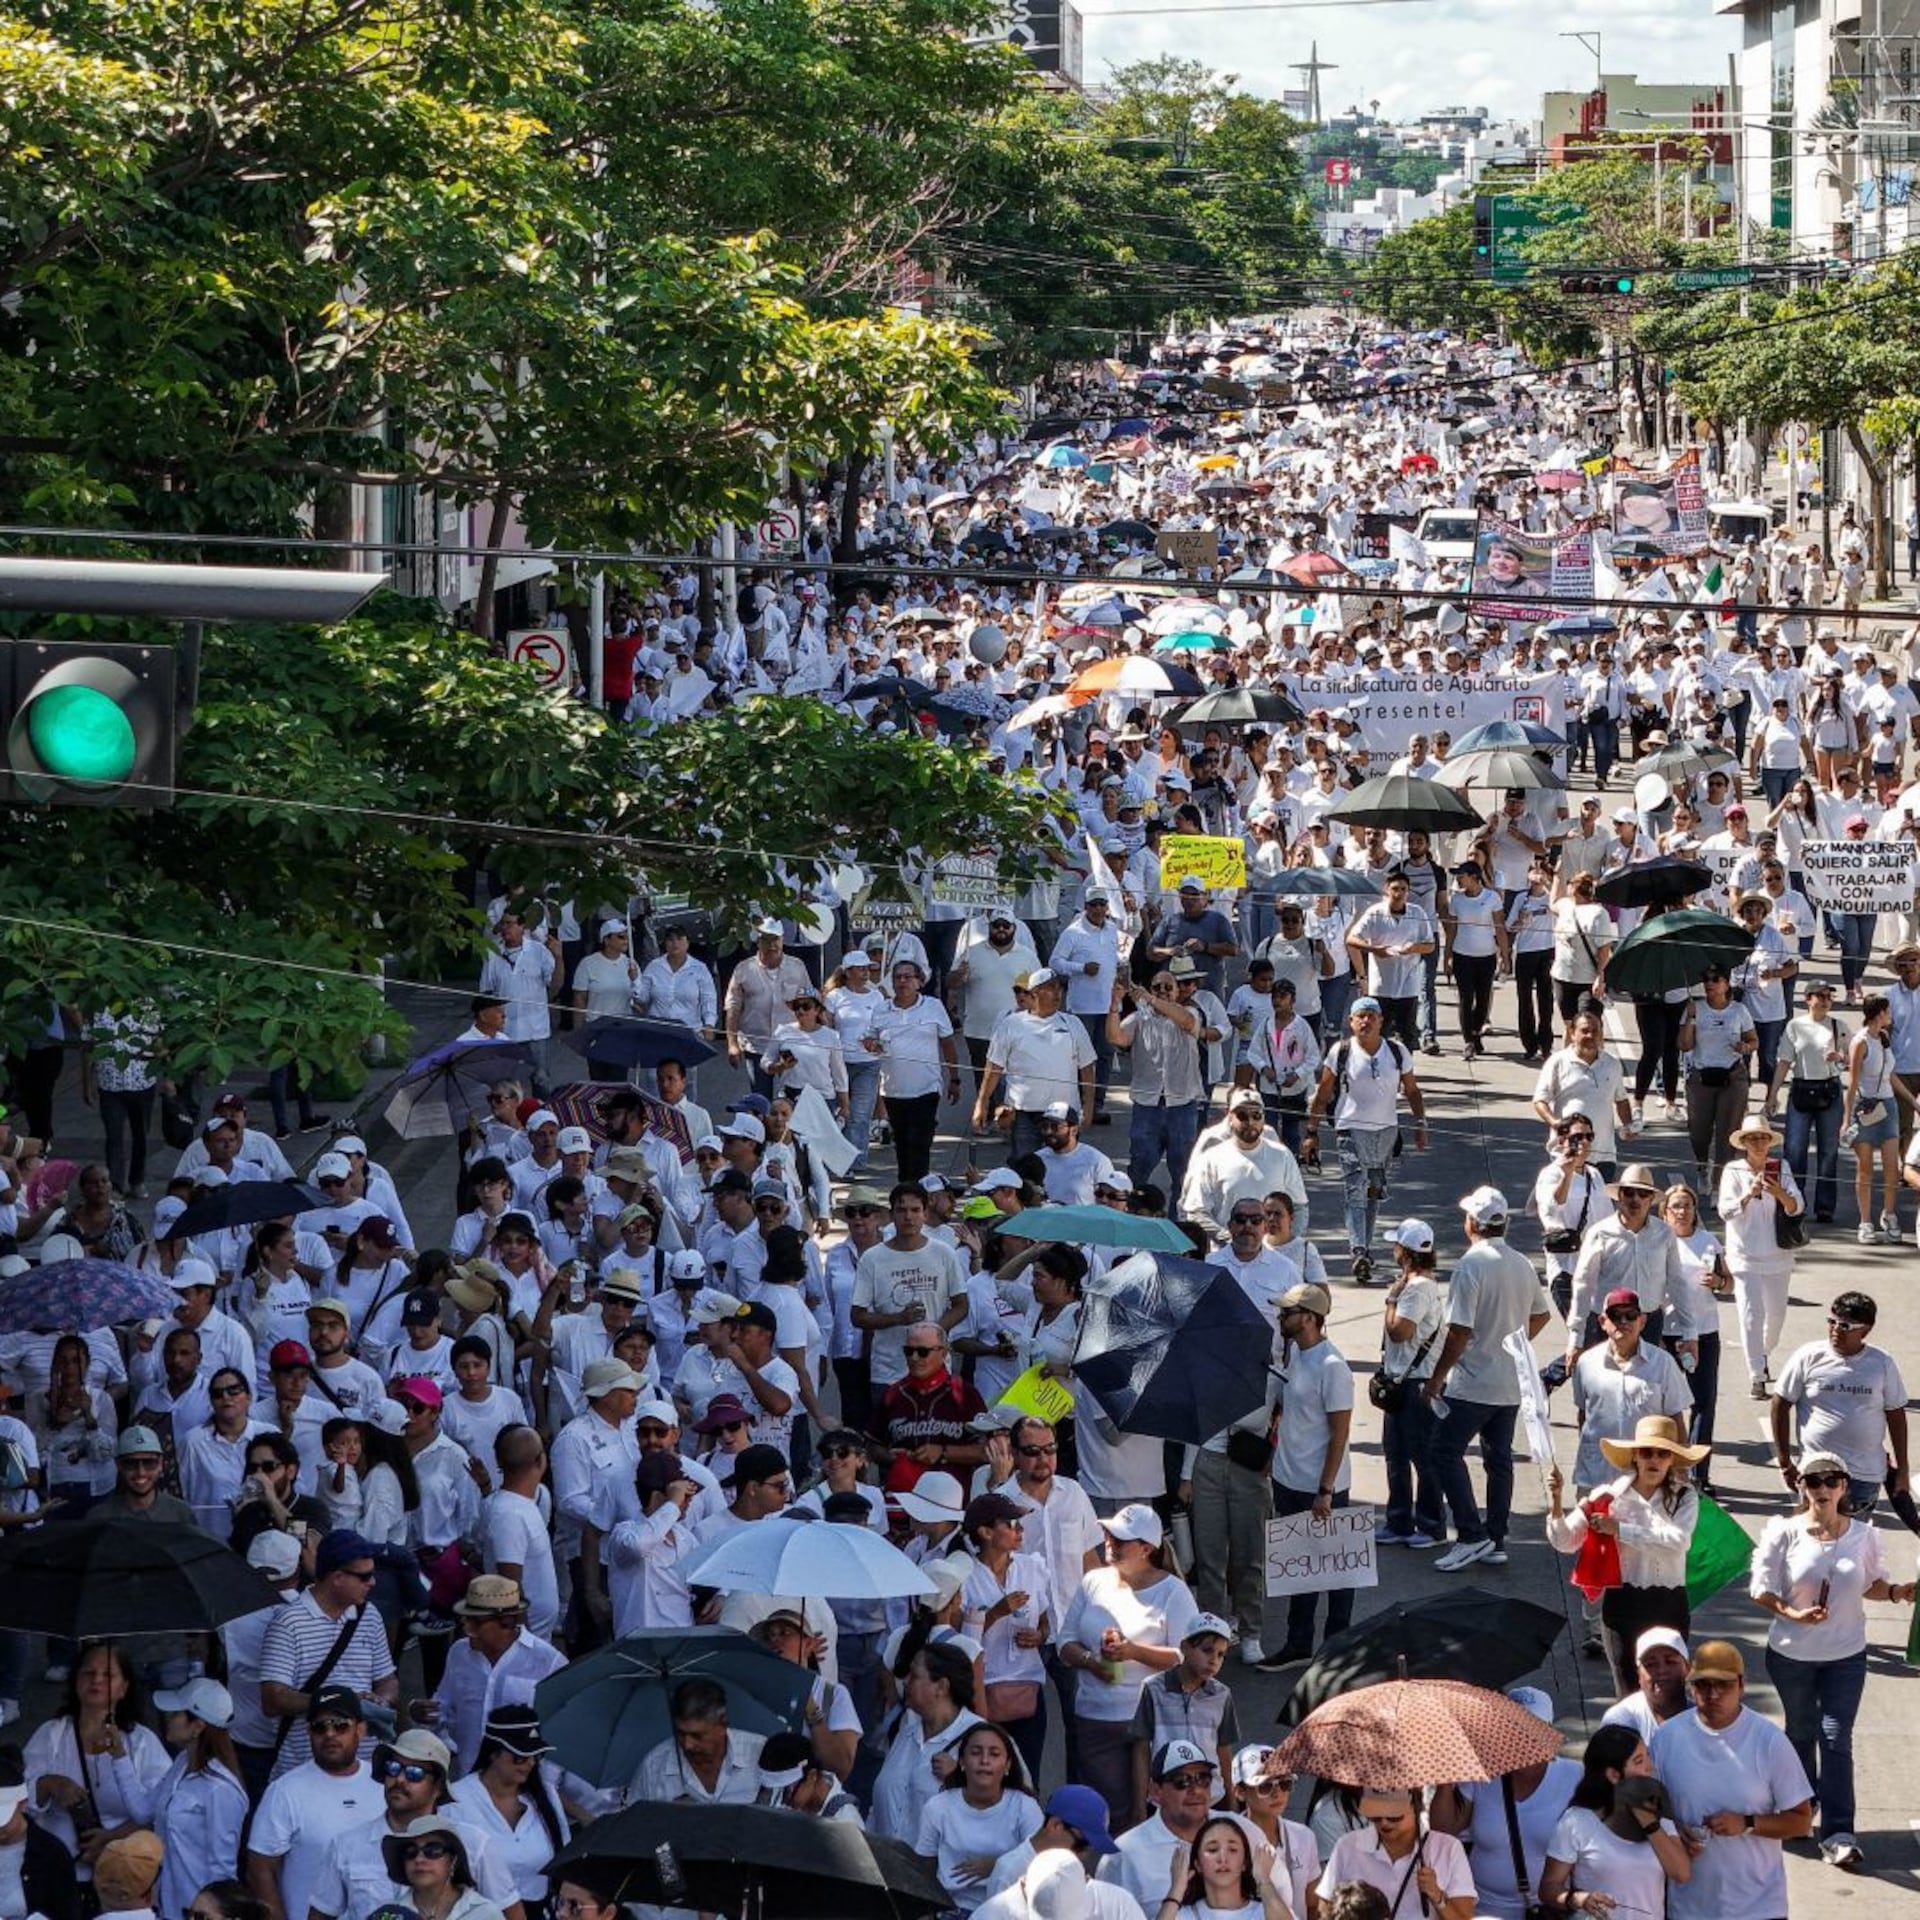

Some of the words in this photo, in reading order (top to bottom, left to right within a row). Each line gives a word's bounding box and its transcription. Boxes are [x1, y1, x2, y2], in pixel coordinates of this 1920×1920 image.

[1176, 535, 1204, 549] PAZ
[1300, 677, 1321, 692] La
[1326, 675, 1418, 694] sindicatura
[1423, 675, 1443, 692] de
[1801, 842, 1829, 854] SOY
[1831, 842, 1916, 855] MANICURISTA
[1804, 856, 1862, 869] QUIERO
[1868, 855, 1910, 868] SALIR
[1806, 875, 1815, 886] A
[1826, 872, 1907, 886] TRABAJAR
[1840, 887, 1874, 898] CON
[1838, 1383, 1873, 1396] Angeles
[888, 1416, 964, 1441] Tomateros
